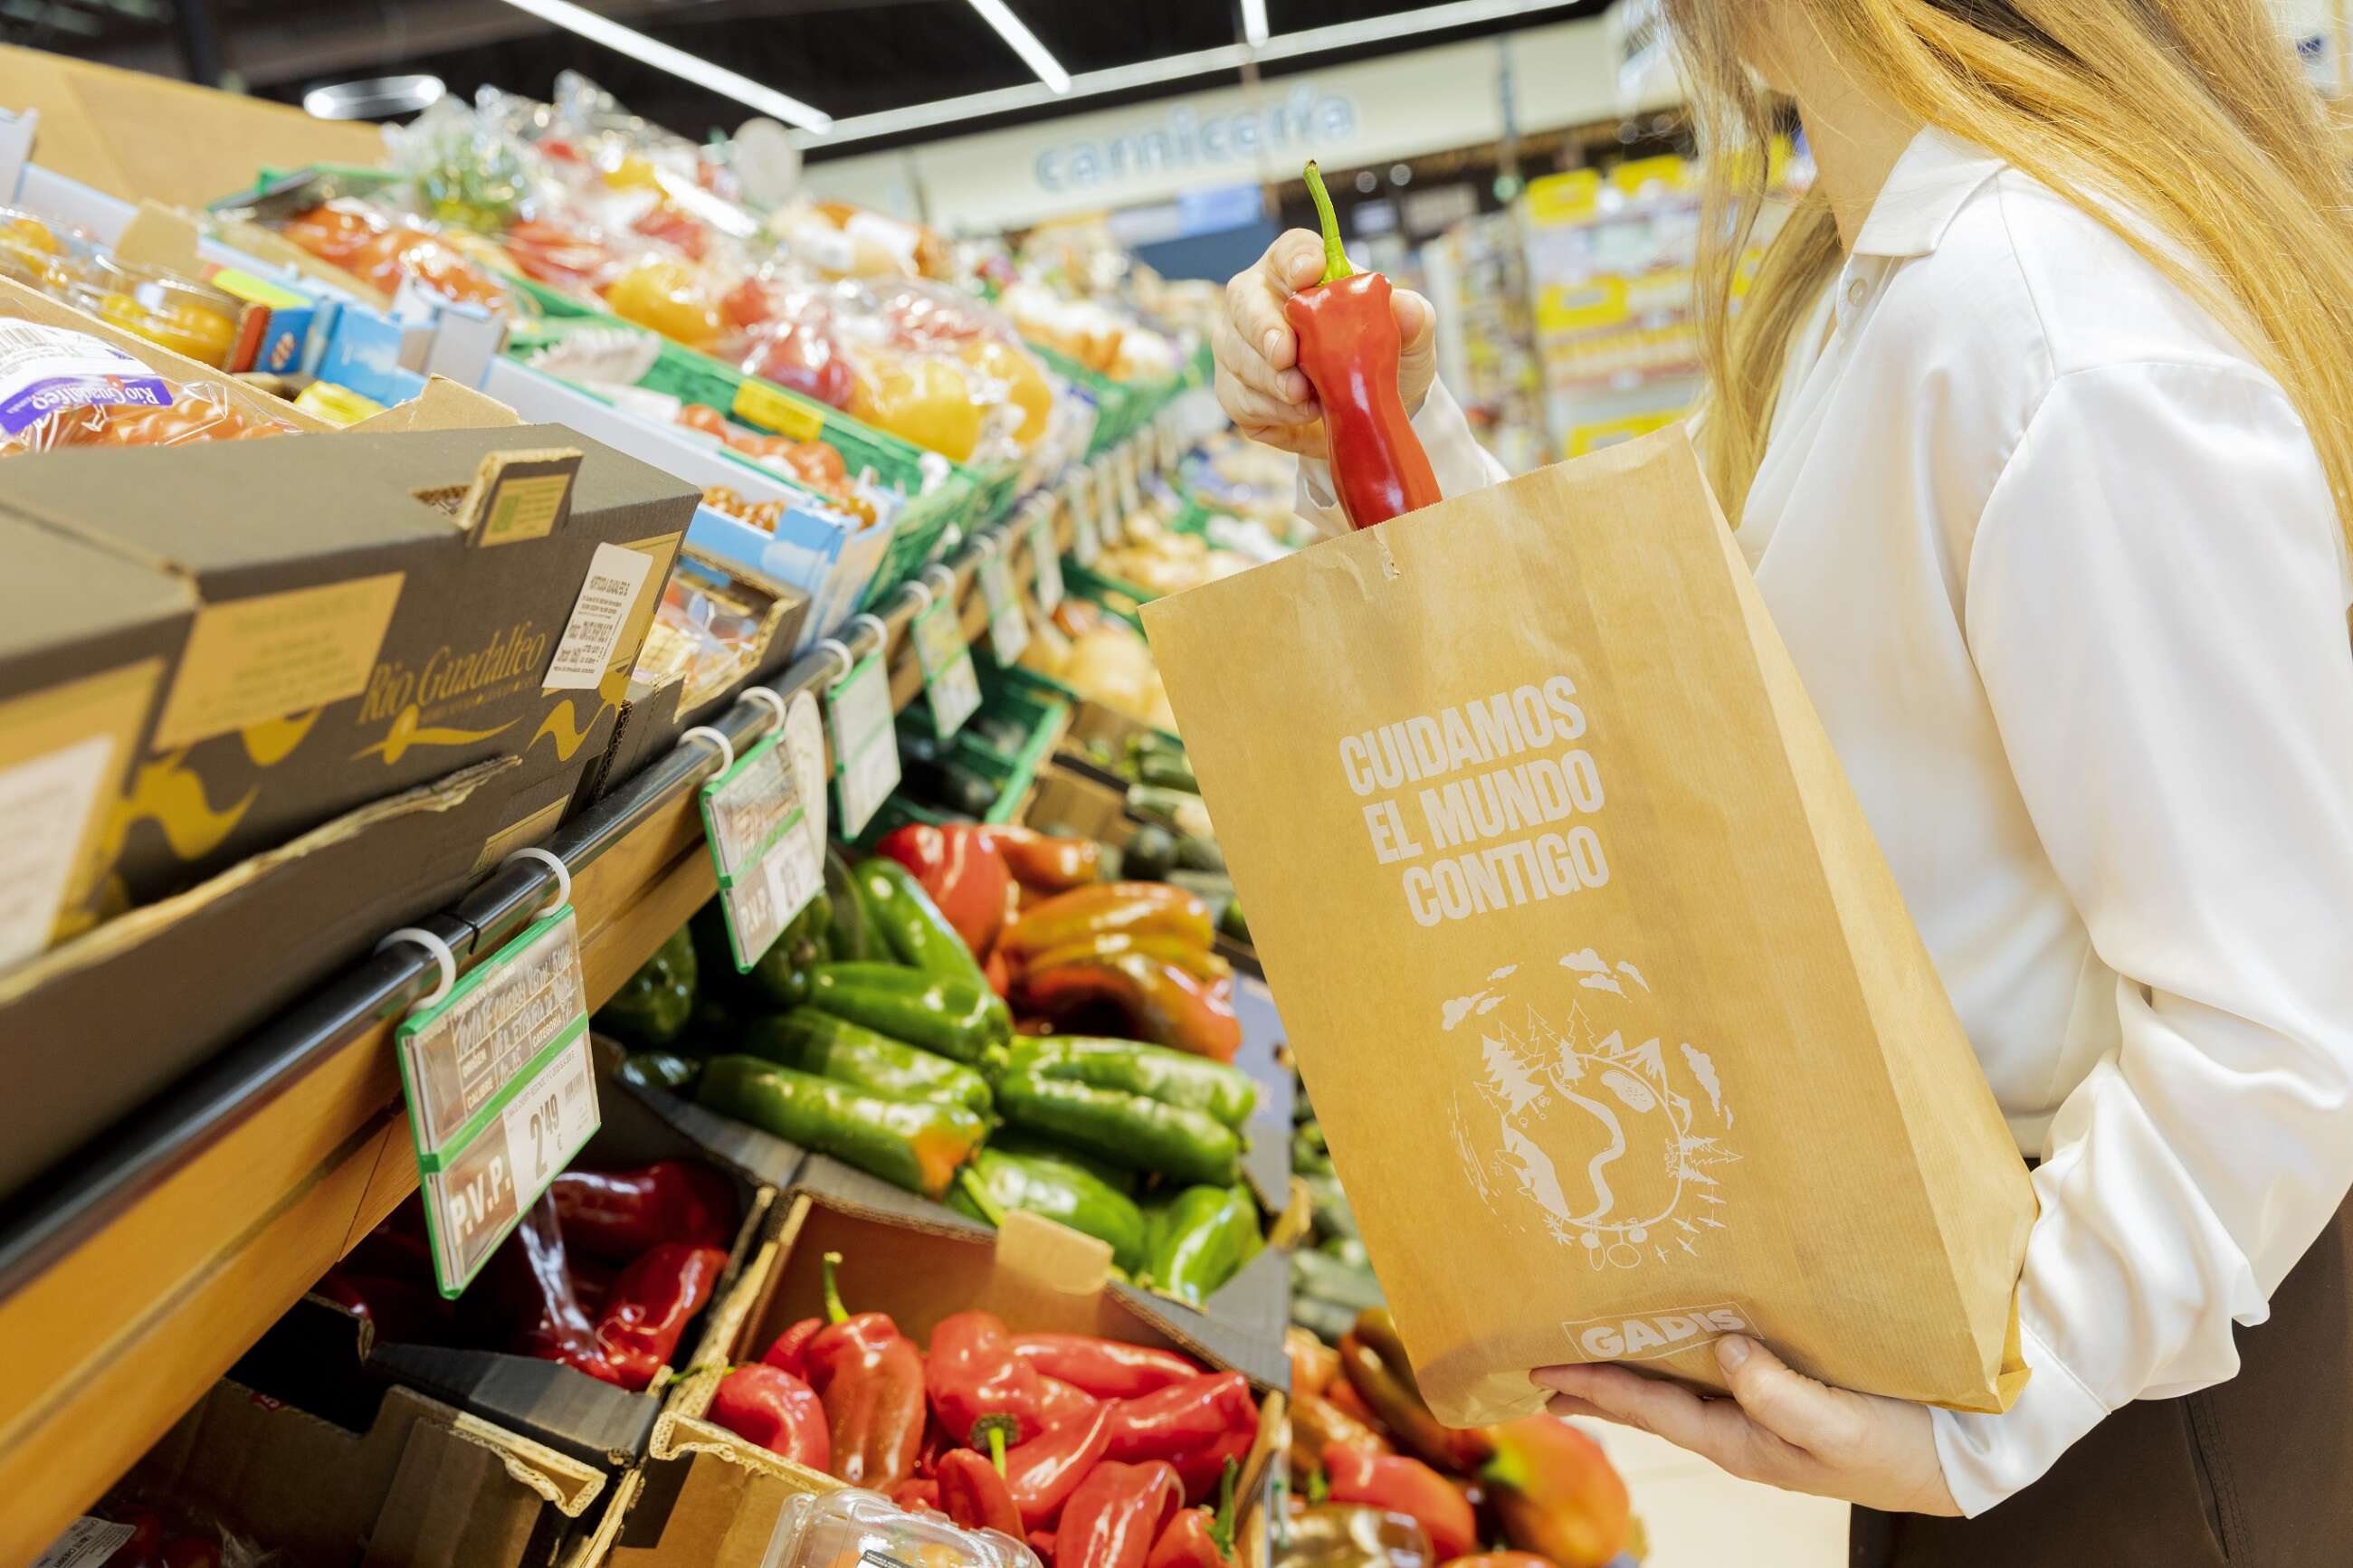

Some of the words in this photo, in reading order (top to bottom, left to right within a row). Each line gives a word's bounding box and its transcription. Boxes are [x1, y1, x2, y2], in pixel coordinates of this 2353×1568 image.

[417, 621, 547, 707] Guadalfeo
[1338, 675, 1586, 796] CUIDAMOS
[1361, 799, 1424, 865] EL
[1419, 748, 1605, 850] MUNDO
[1402, 825, 1610, 927] CONTIGO
[449, 1156, 511, 1246] P.V.P.
[1581, 1308, 1746, 1358] GADIS
